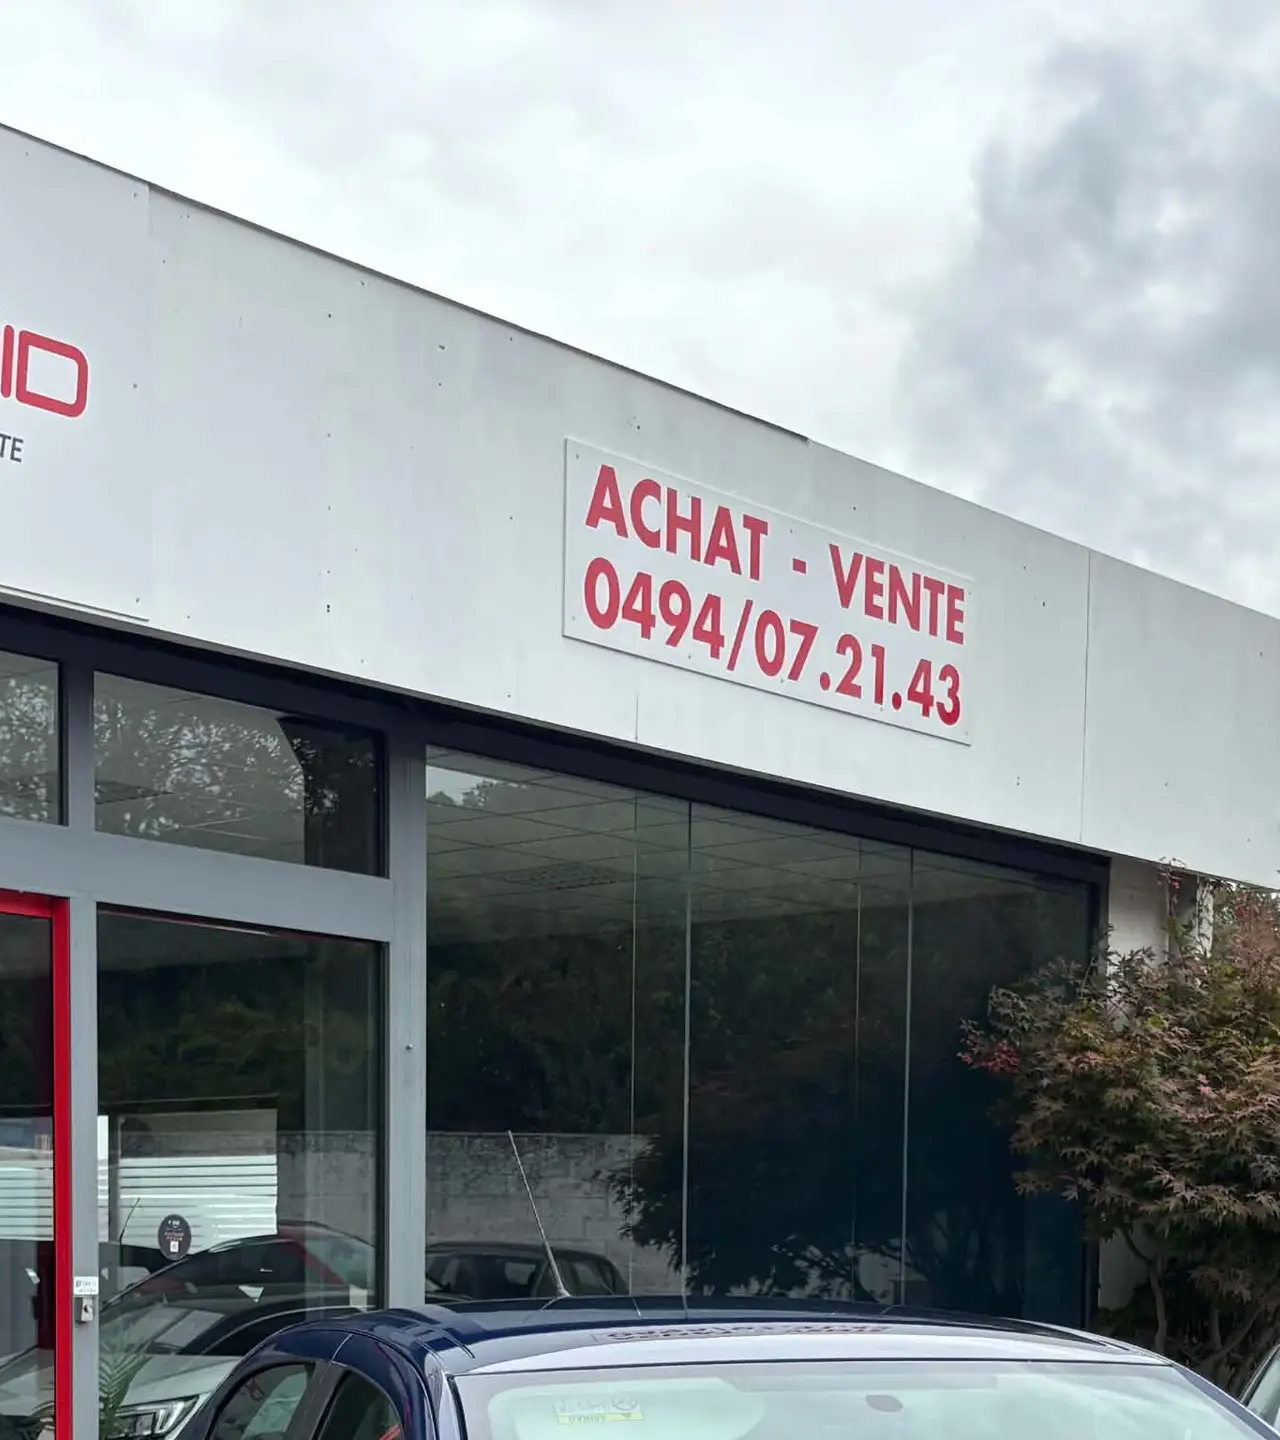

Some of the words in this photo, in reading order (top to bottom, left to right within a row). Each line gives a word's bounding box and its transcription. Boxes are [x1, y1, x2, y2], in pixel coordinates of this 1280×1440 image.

[584, 556, 961, 726] 0494/07.21.43
[585, 464, 768, 581] ACHAT
[829, 543, 965, 645] VENTE
